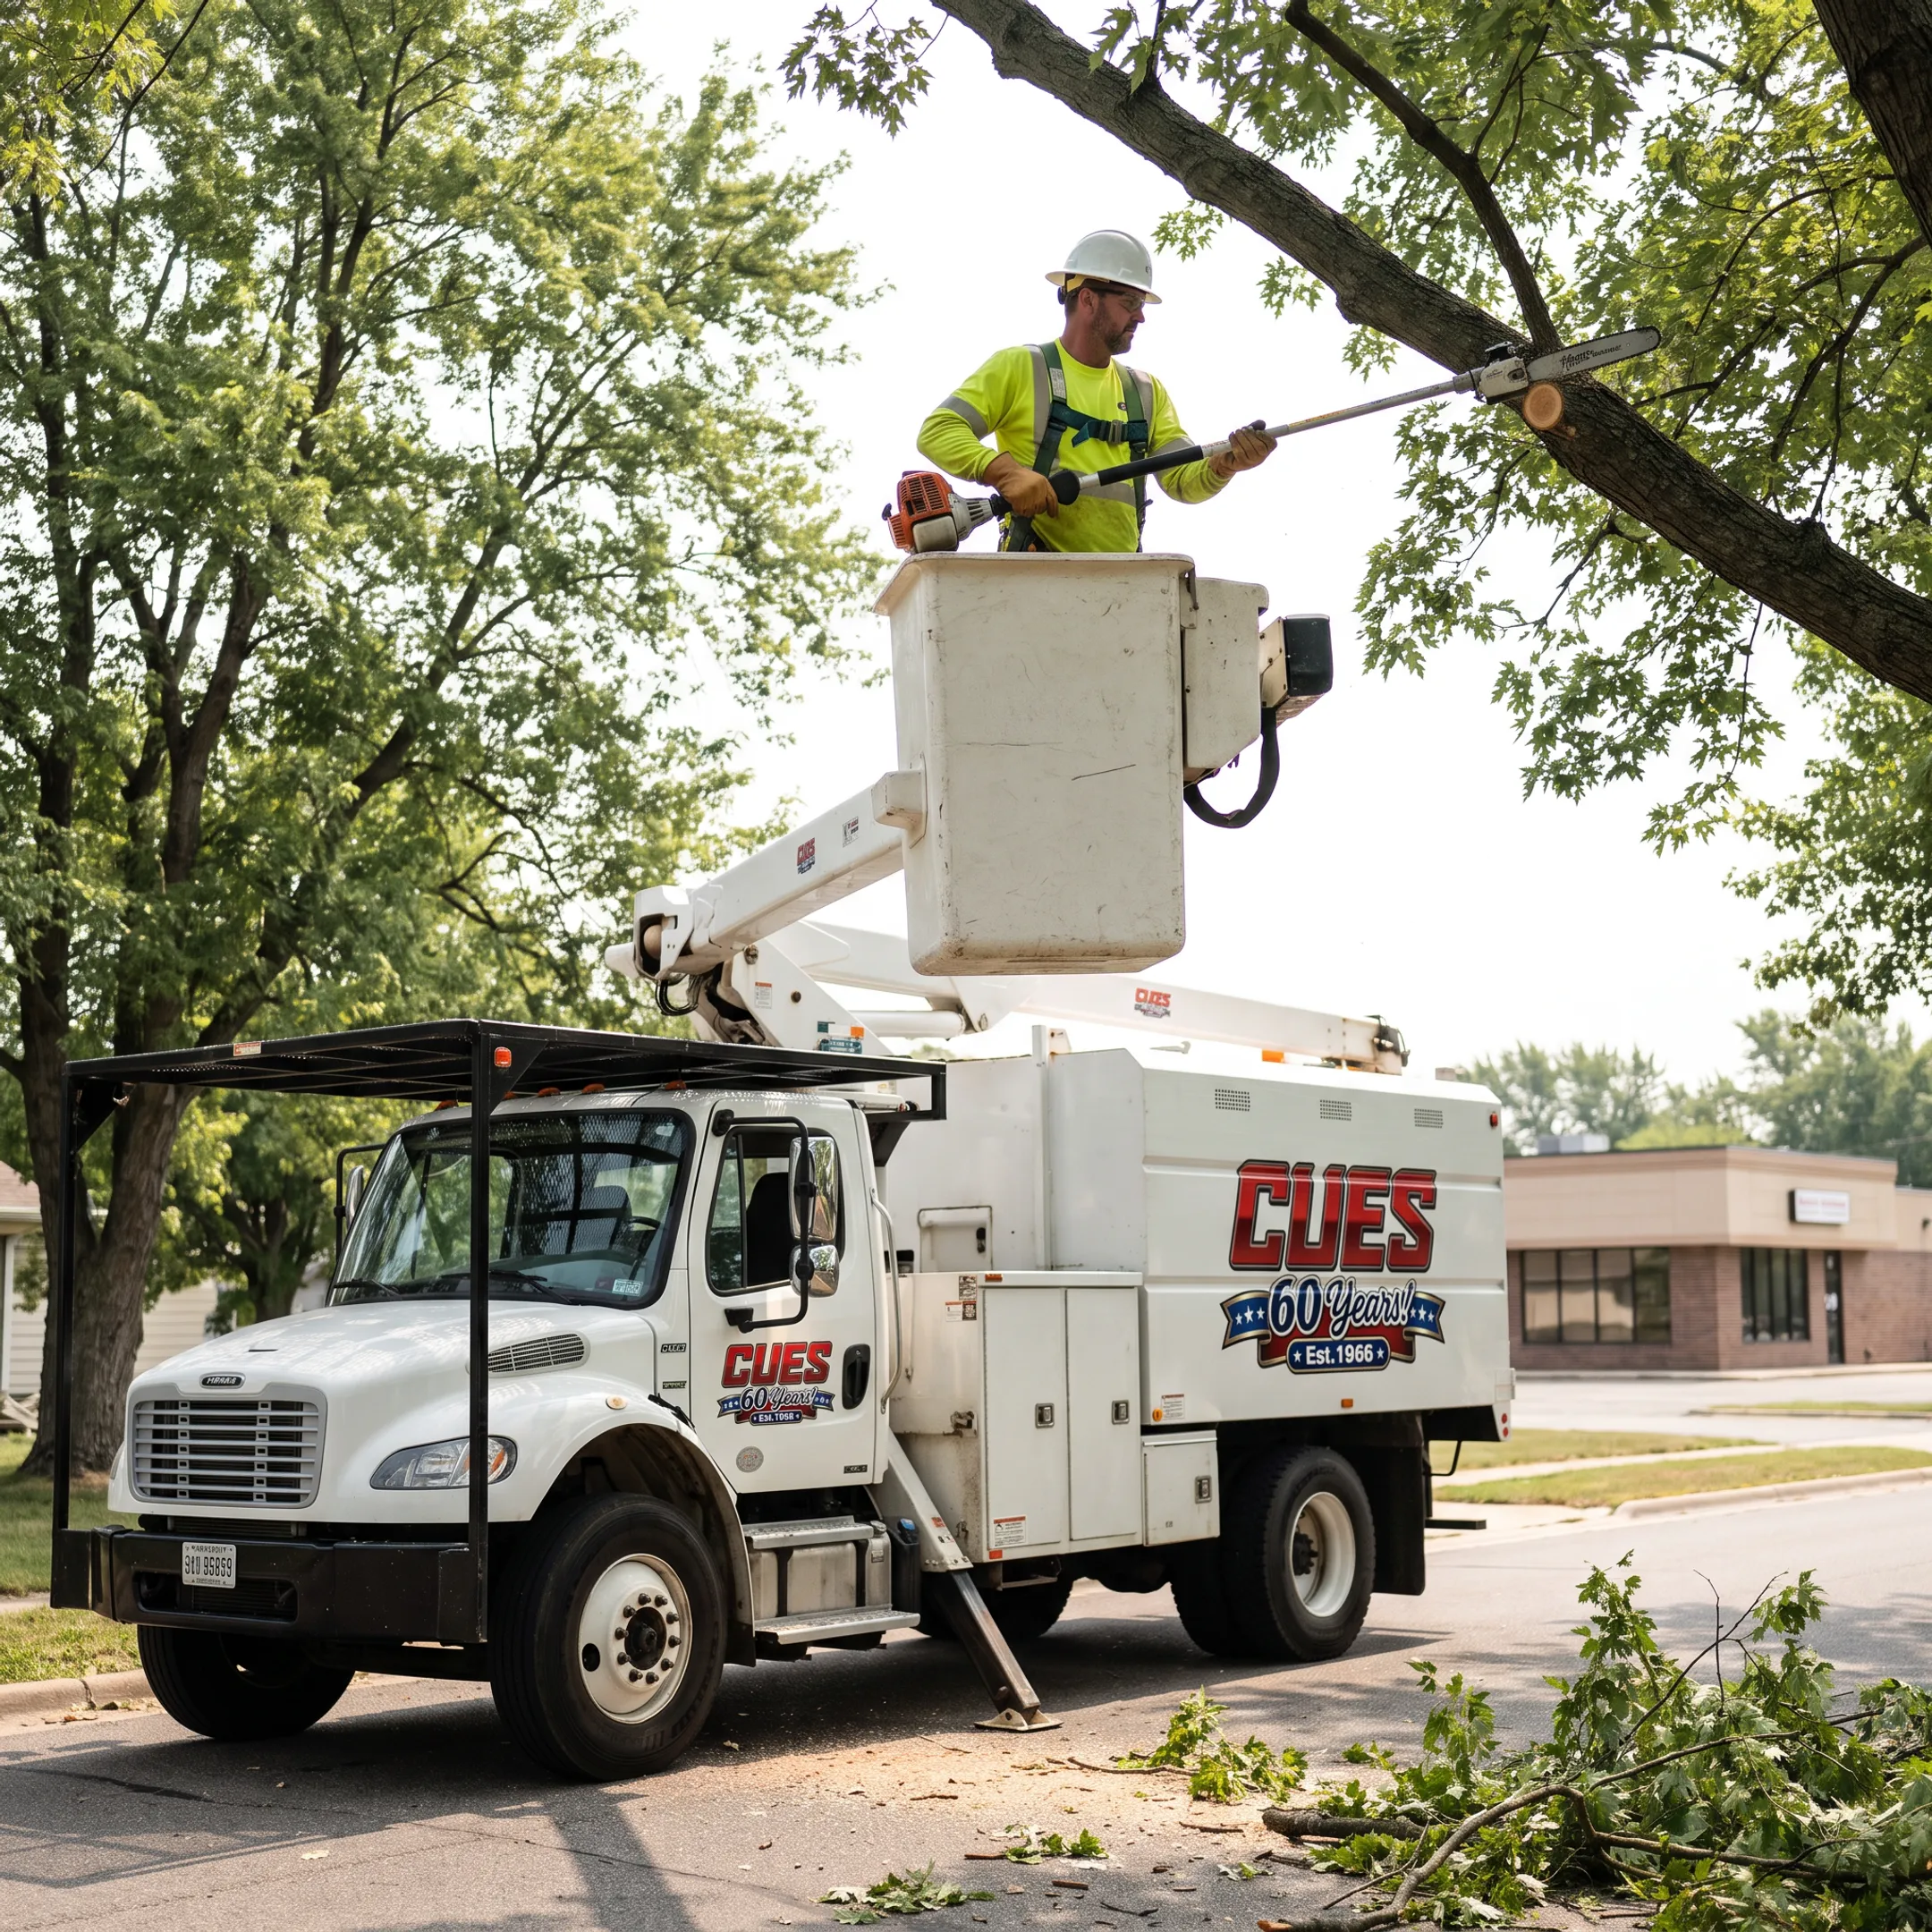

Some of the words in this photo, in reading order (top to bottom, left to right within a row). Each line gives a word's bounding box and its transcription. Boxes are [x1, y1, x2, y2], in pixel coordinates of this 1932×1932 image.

[1229, 1159, 1436, 1273] CUES
[1268, 1275, 1324, 1336] 60
[1324, 1276, 1417, 1341] Years!
[721, 1341, 833, 1388] CUES
[1306, 1345, 1335, 1365] Est.
[1336, 1343, 1374, 1364] 1966
[740, 1386, 769, 1411] 60
